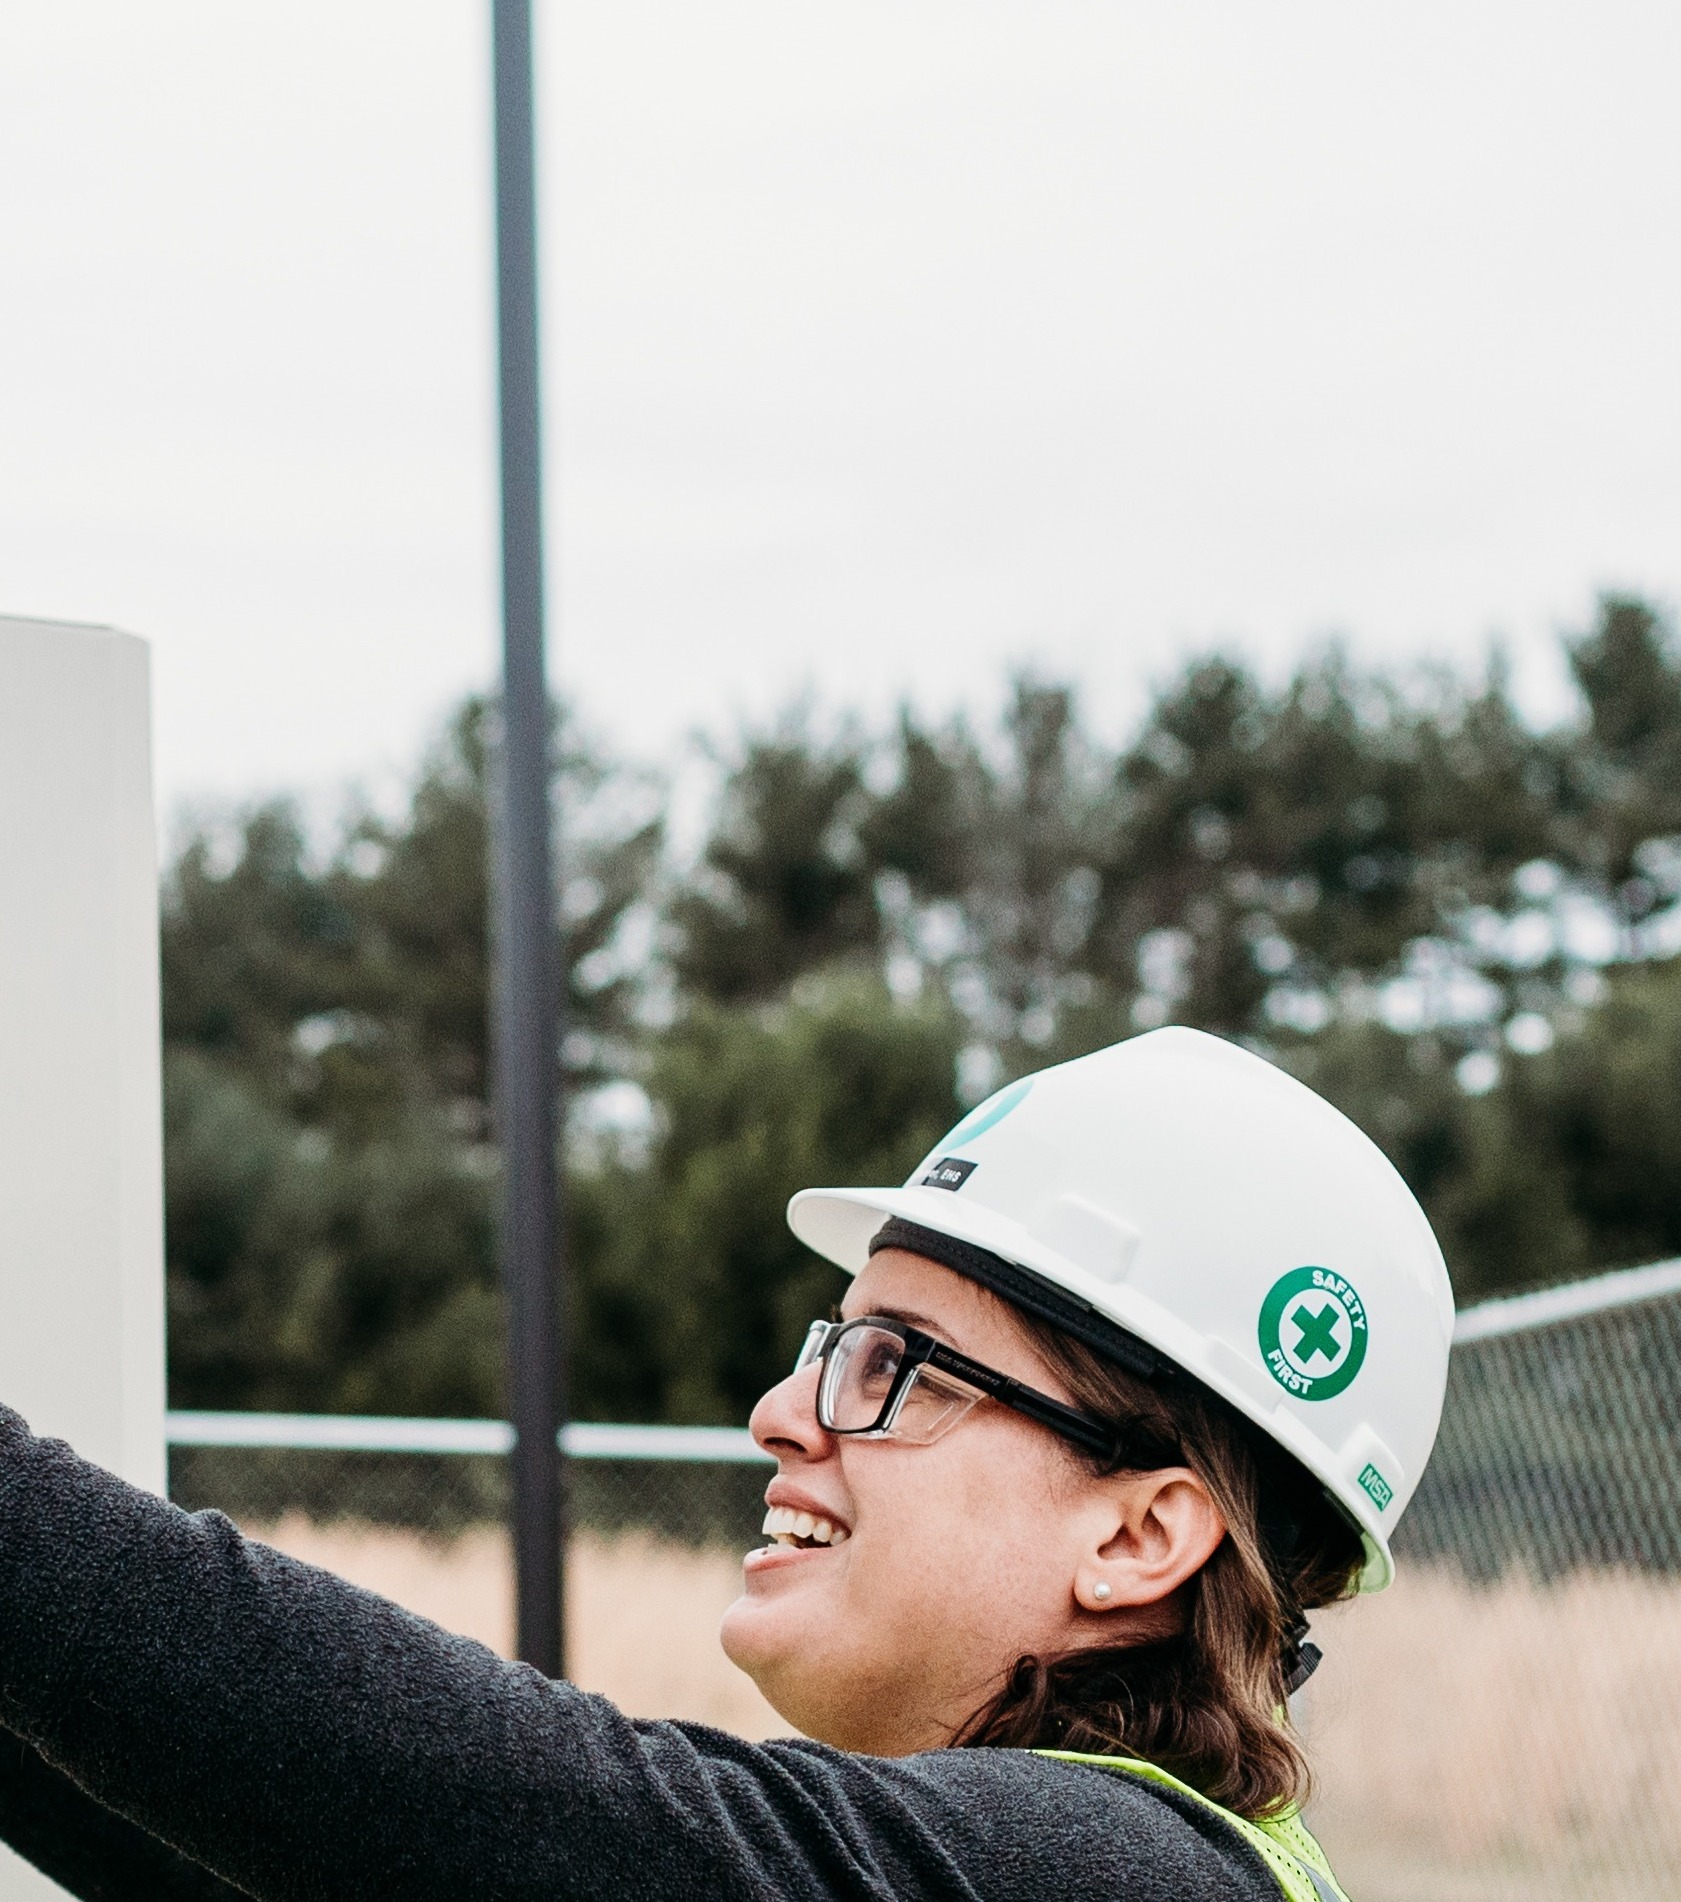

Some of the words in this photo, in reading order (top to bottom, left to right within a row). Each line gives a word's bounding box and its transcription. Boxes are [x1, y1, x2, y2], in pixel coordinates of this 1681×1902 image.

[940, 1168, 962, 1182] EHS
[1312, 1270, 1365, 1330] SAFETY
[1268, 1348, 1313, 1394] FIRST
[1360, 1467, 1391, 1510] MSA
